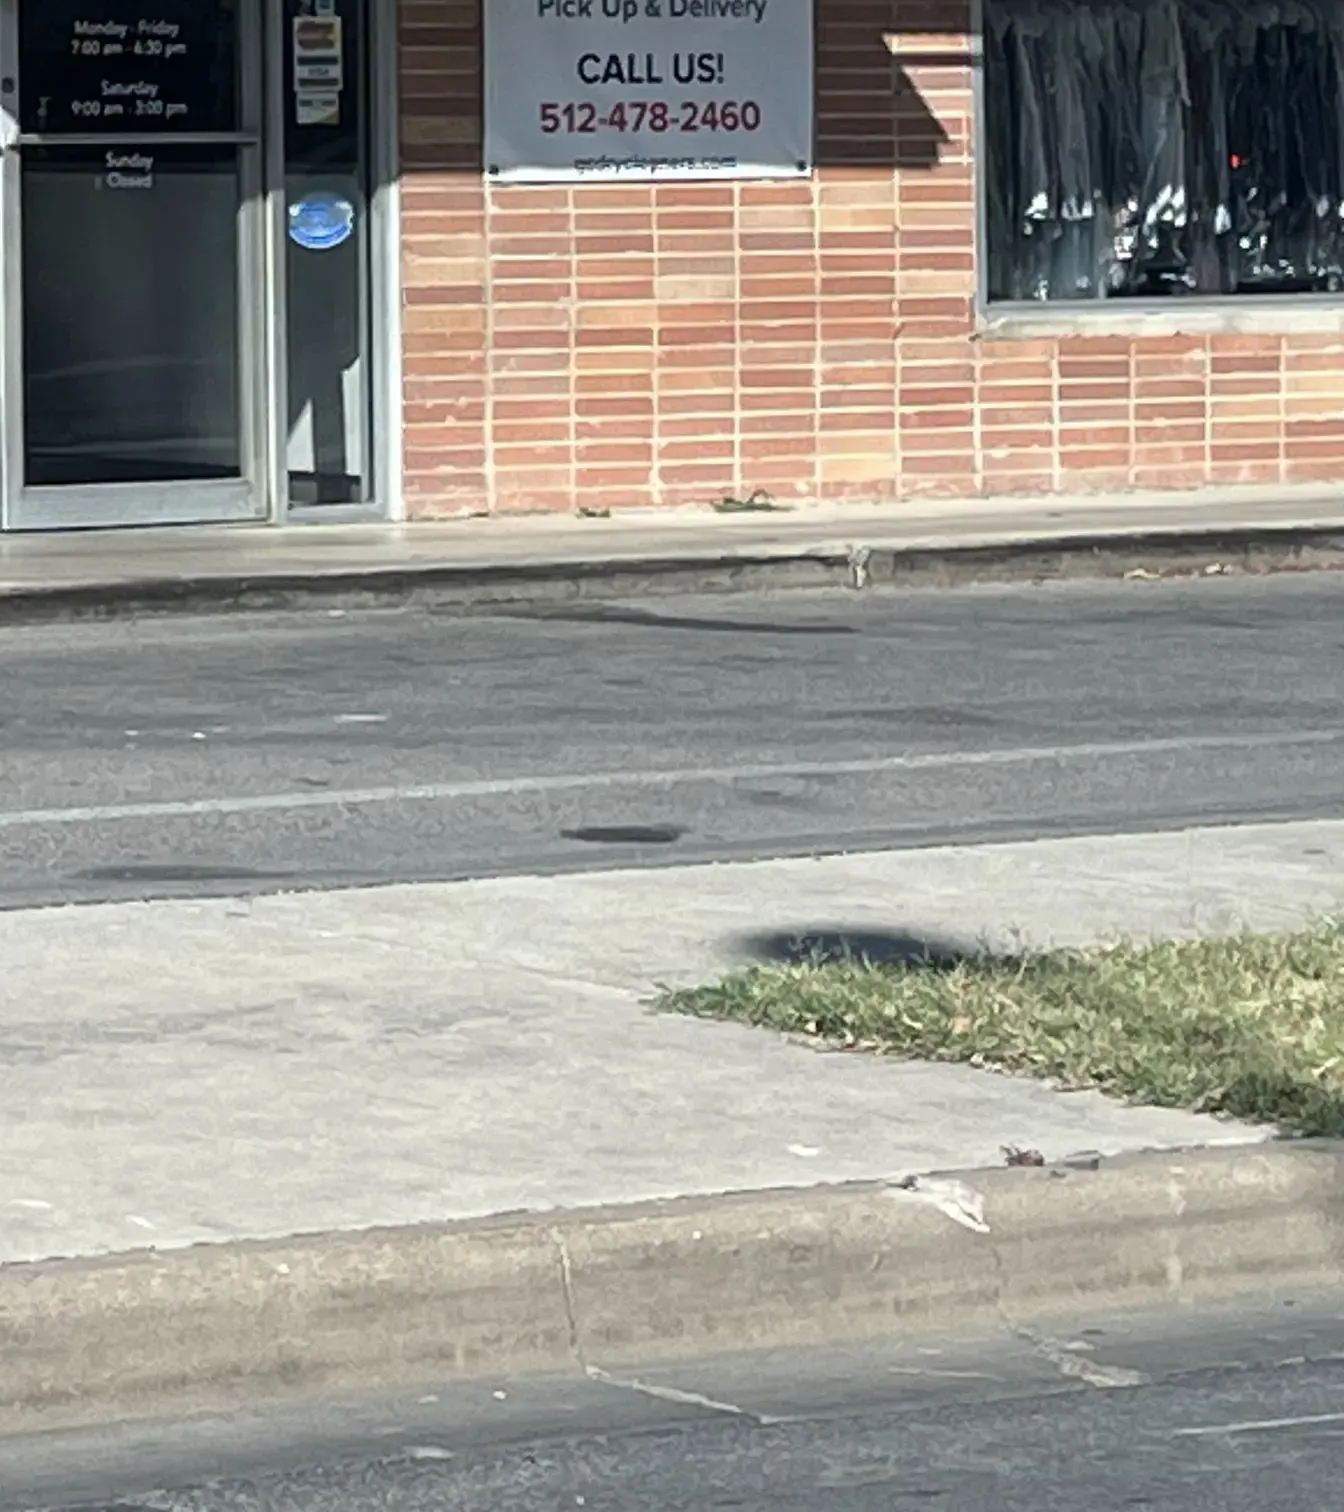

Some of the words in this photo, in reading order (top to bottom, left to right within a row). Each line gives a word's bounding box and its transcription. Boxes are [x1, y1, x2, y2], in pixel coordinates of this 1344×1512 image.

[577, 53, 662, 84] CALL
[672, 53, 724, 84] US!
[540, 100, 761, 133] 512-478-2460
